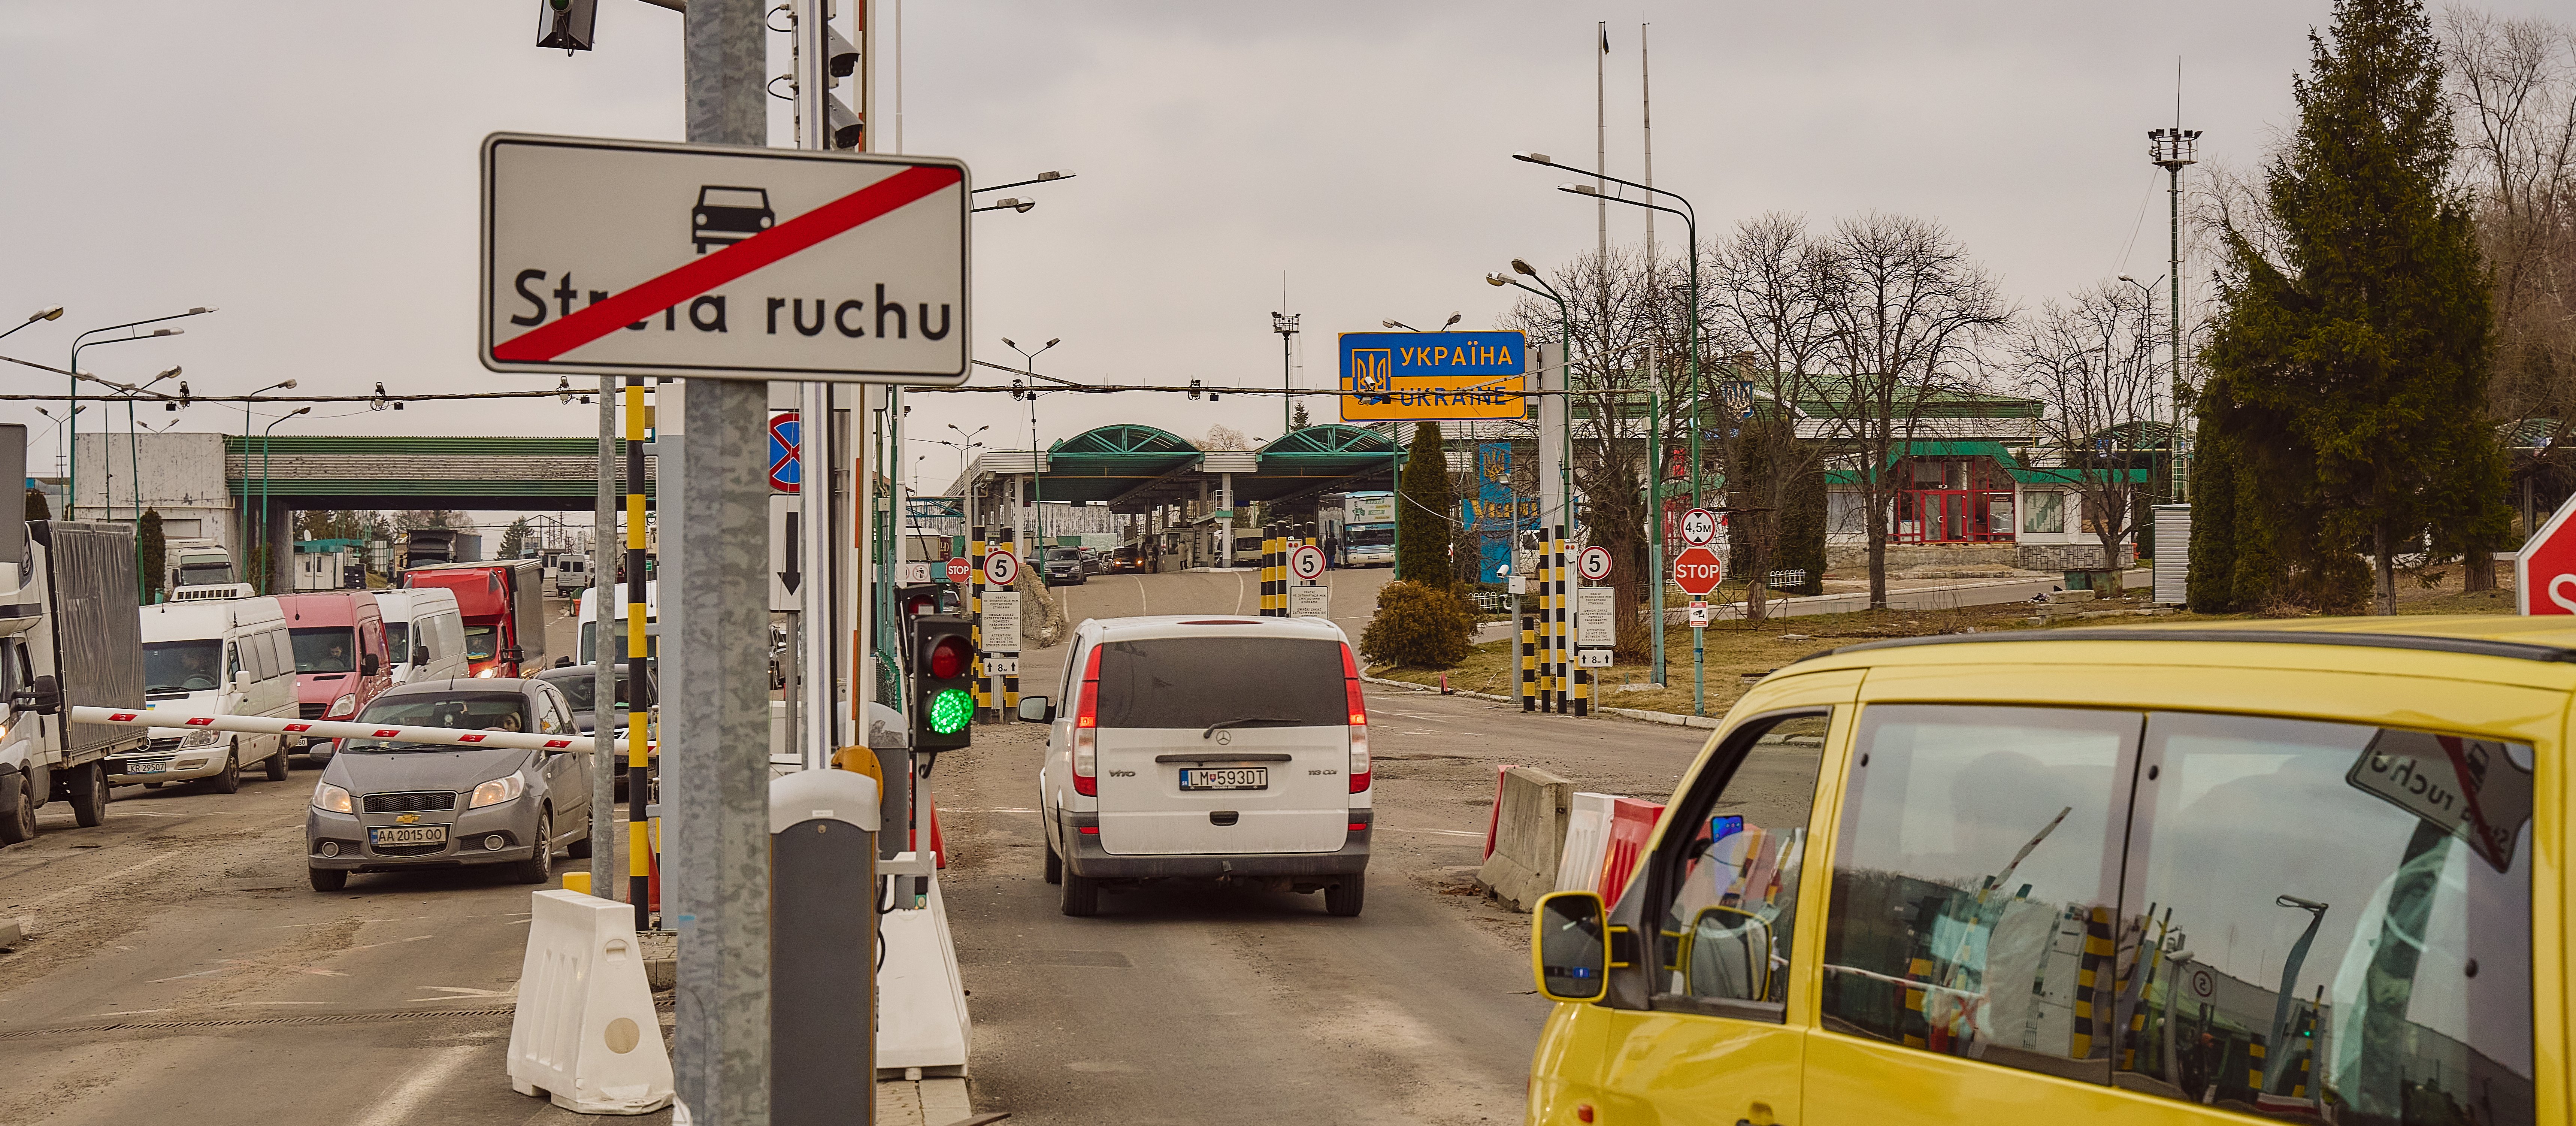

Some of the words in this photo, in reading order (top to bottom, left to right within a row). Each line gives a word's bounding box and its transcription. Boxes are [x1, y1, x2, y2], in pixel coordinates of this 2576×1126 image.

[767, 284, 950, 340] ruchu
[1400, 340, 1513, 366] УКРАЇНА
[1401, 387, 1506, 406] UKRAINE
[948, 566, 969, 575] STOP
[995, 559, 1007, 578] 5
[1302, 555, 1314, 573] 5
[1589, 555, 1600, 573] 5
[1676, 564, 1719, 578] STOP
[142, 763, 164, 772] 29507
[1190, 771, 1209, 786] LM
[1217, 770, 1264, 785] 593DT
[378, 830, 394, 842] AA
[397, 829, 423, 841] 2015
